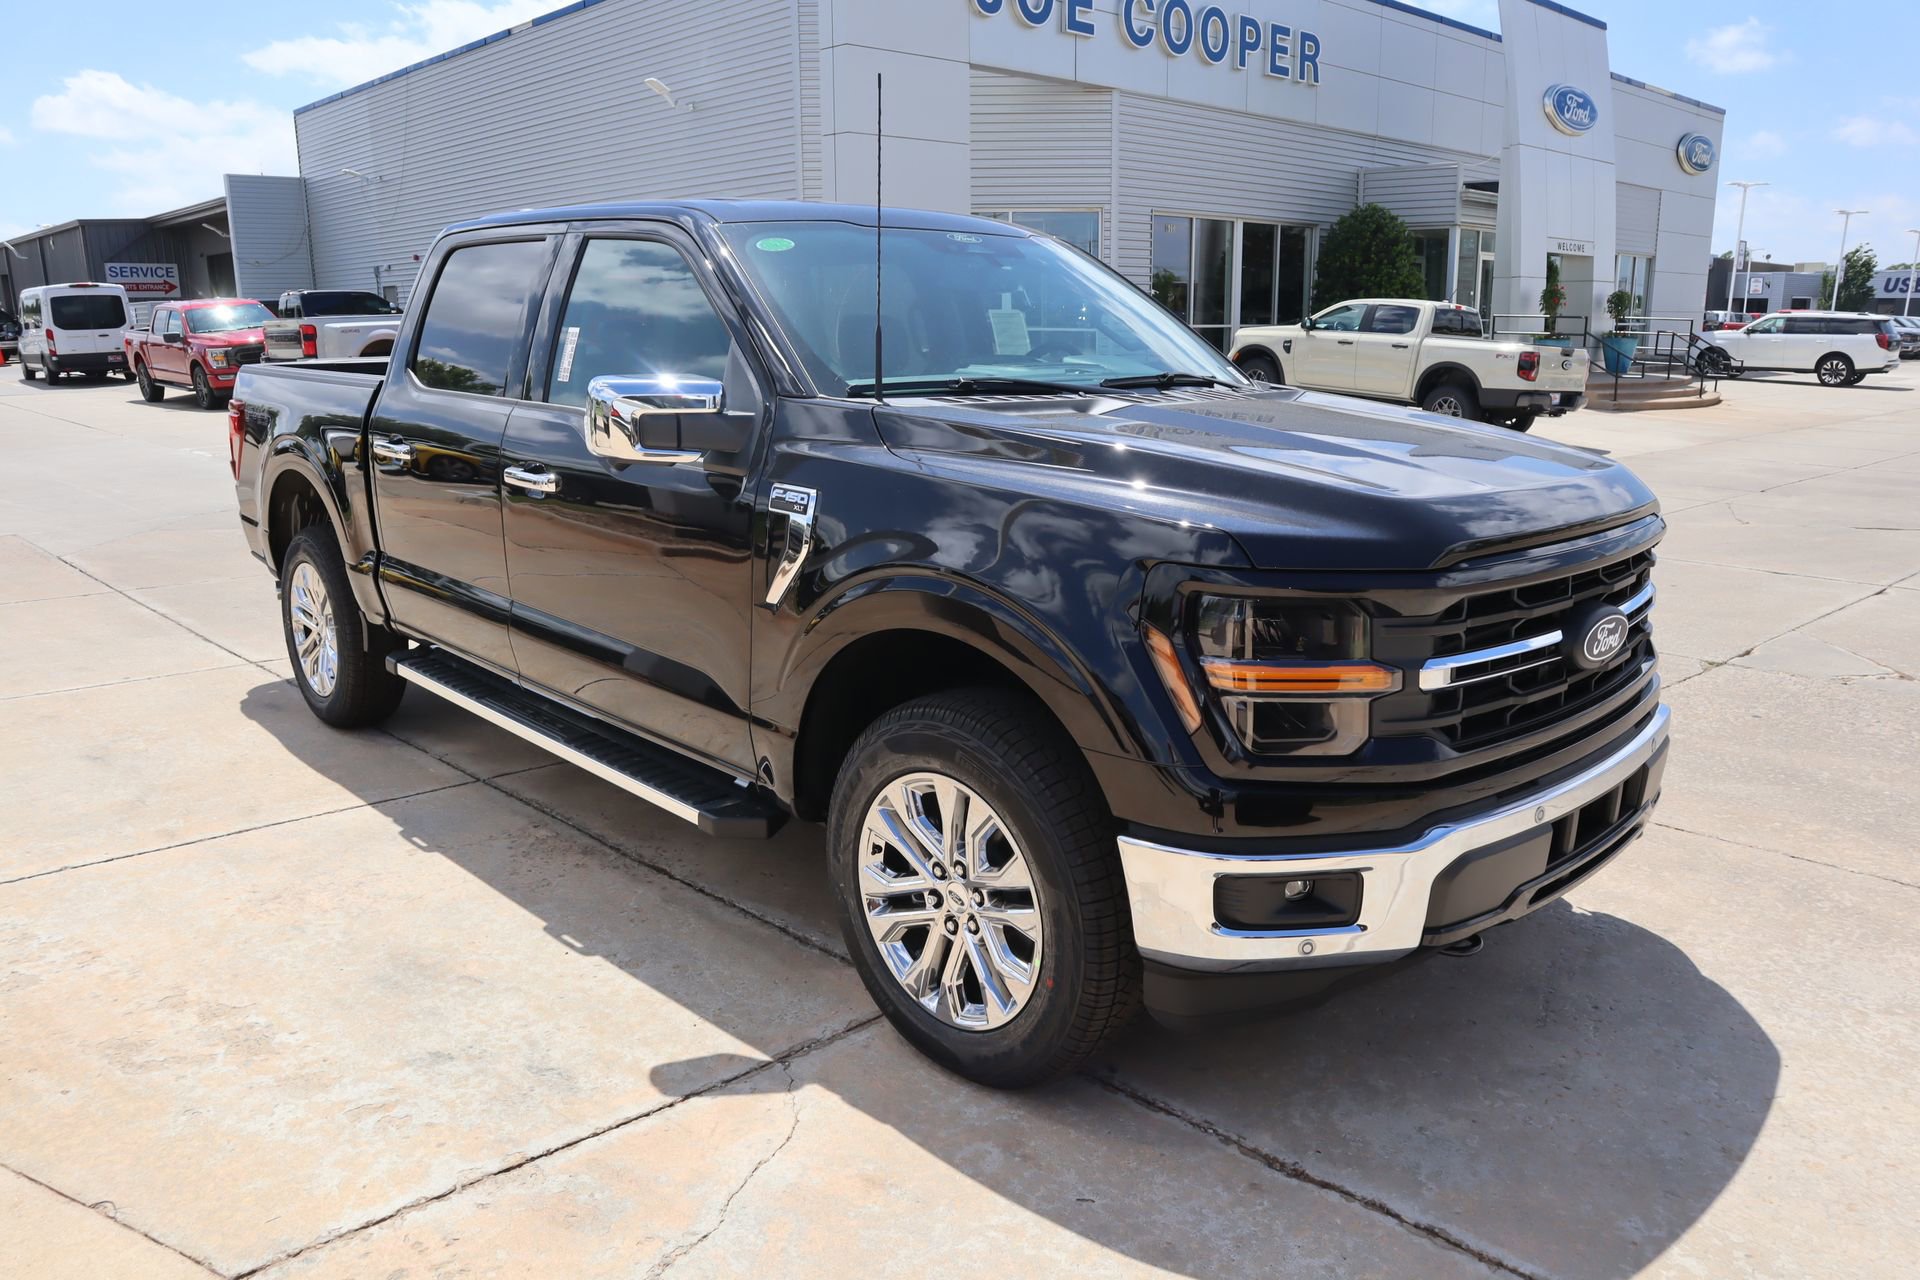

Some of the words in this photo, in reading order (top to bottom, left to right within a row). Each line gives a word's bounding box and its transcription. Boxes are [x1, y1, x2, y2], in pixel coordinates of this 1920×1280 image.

[1120, 0, 1321, 85] COOPER
[1564, 94, 1591, 123] Ford
[1692, 143, 1712, 165] Ford
[1557, 242, 1585, 253] WELCOME
[108, 265, 175, 278] SERVICE
[1593, 621, 1622, 656] Ford
